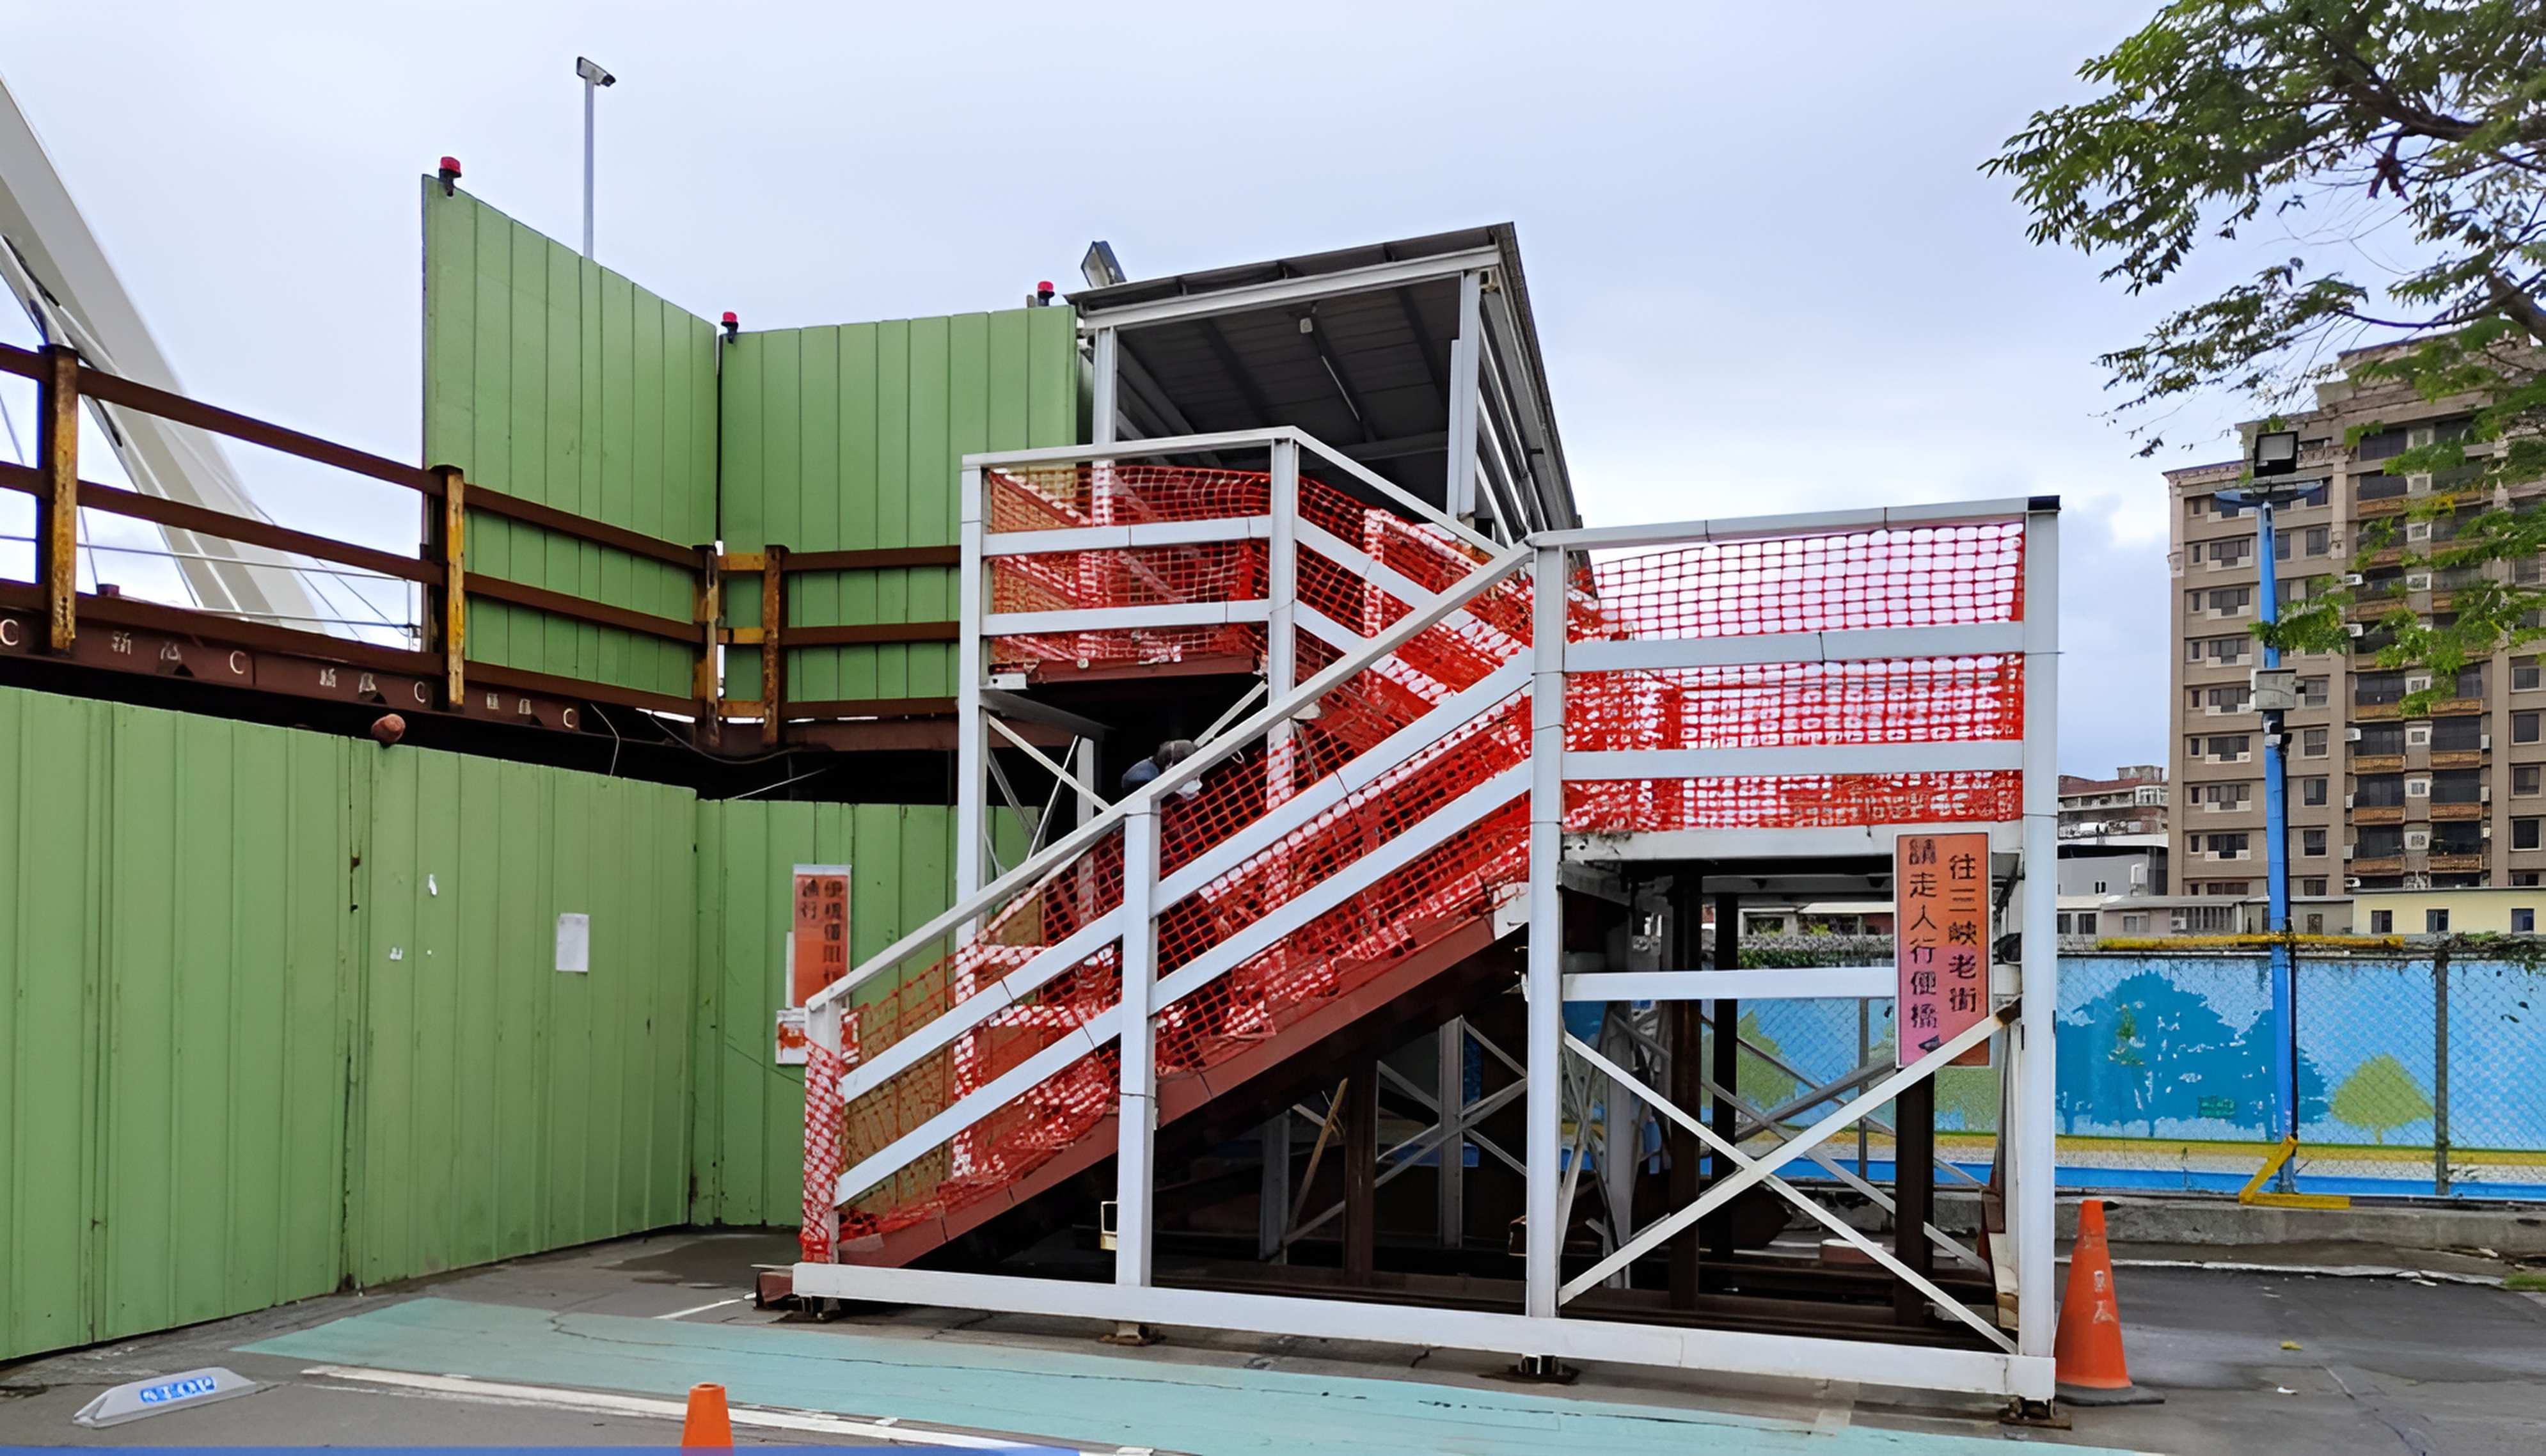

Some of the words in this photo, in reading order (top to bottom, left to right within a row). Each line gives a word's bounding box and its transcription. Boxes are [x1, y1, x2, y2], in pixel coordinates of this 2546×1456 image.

[1948, 853, 1977, 1013] 往三峽老街
